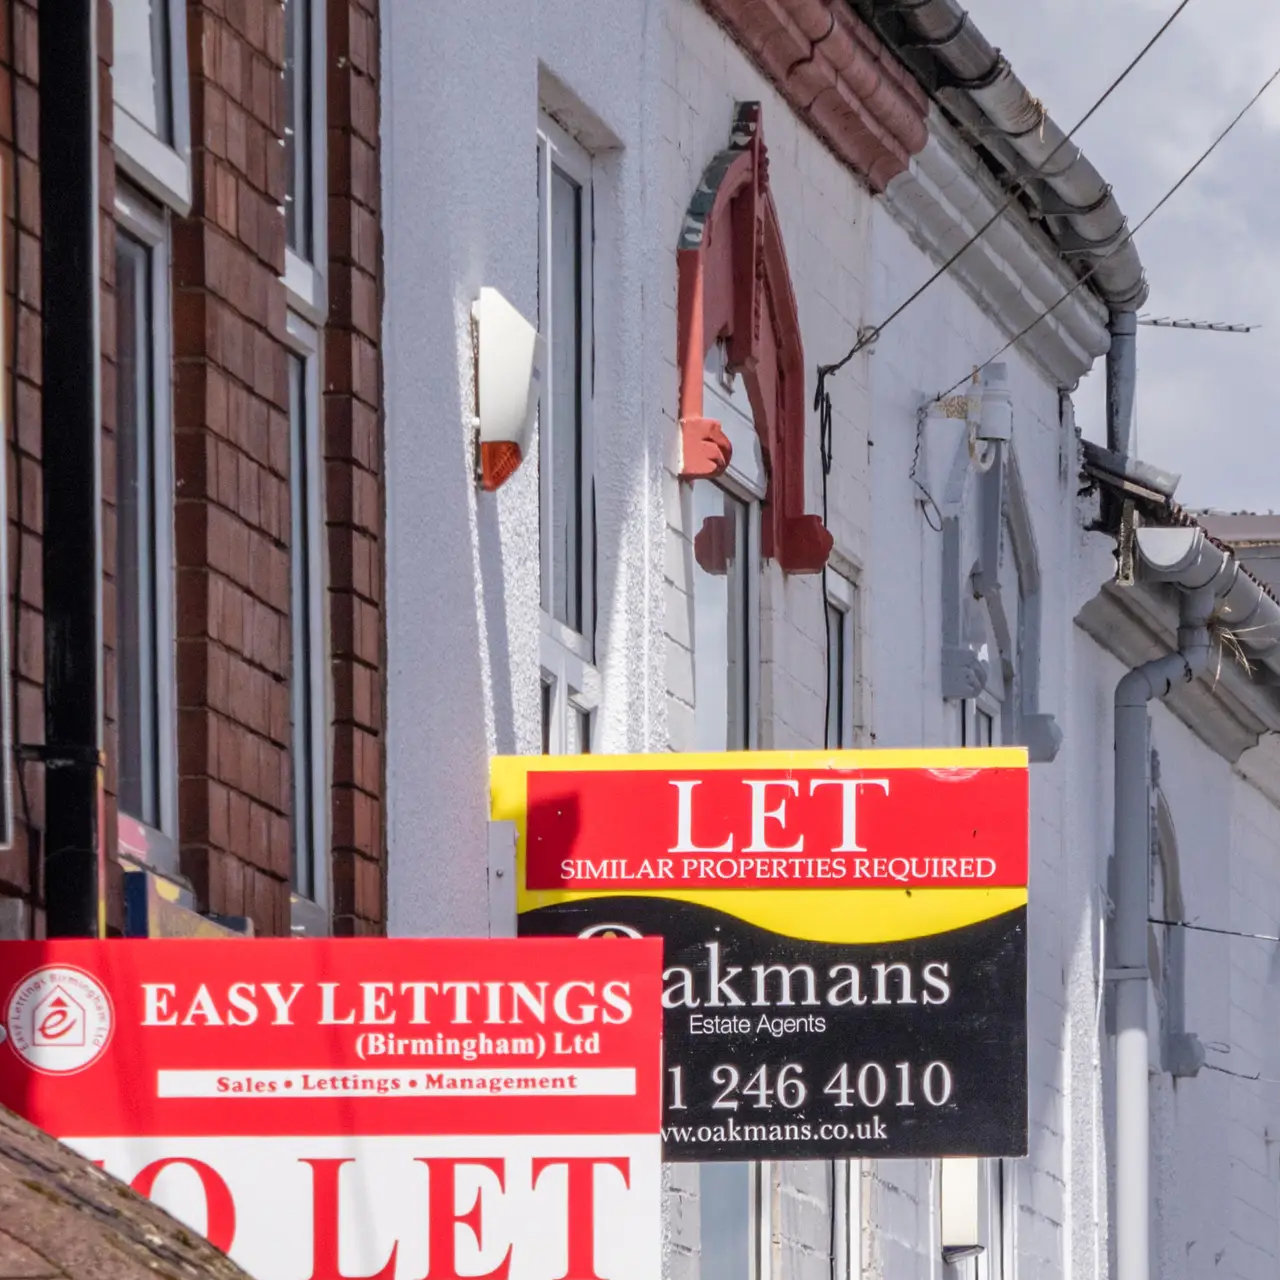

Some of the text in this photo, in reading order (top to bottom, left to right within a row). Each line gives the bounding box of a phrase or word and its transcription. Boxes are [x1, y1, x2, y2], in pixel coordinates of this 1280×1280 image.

[667, 778, 889, 854] LET
[560, 857, 997, 881] SIMILAR PROPERTIES REQUIRED
[578, 923, 952, 1009] akmans
[140, 981, 633, 1027] EASY LETTINGS
[690, 1013, 826, 1038] Estate Agents
[355, 1033, 601, 1061] (Birmingham) Ltd
[216, 1072, 578, 1094] Sales Lettings Management
[712, 1064, 807, 1111] 246
[824, 1061, 952, 1107] 4010
[96, 1157, 237, 1257] O
